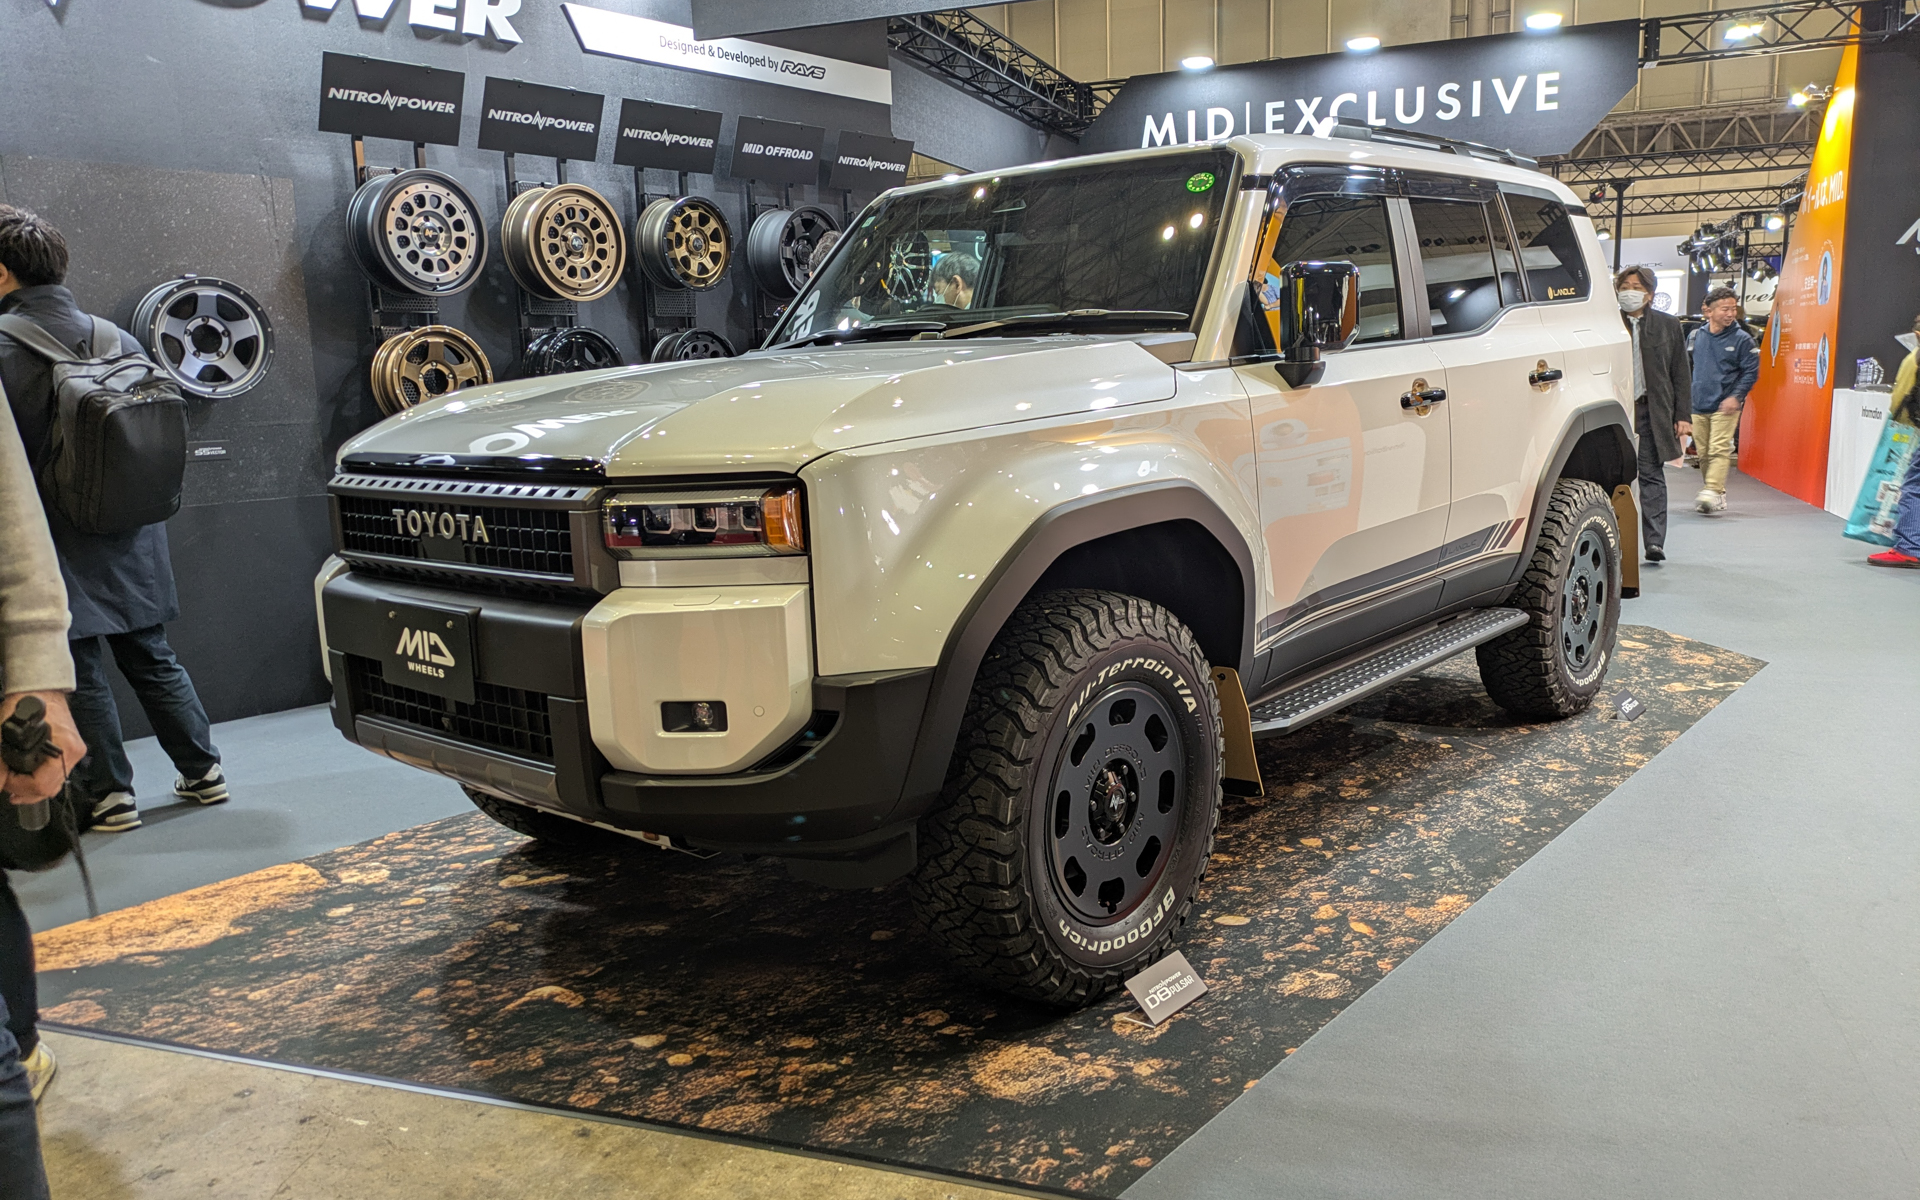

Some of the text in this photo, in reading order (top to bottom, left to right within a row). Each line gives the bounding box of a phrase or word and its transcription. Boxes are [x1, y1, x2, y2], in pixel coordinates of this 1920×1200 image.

[659, 35, 826, 80] Designed & Developed by RAYS
[1141, 72, 1560, 148] MID EXCLUSIVE
[742, 142, 813, 161] MID OFFROAD
[1862, 405, 1883, 420] Information
[392, 508, 490, 543] TOYOTA
[396, 626, 456, 667] MID
[407, 660, 445, 678] WHEELS
[1066, 657, 1174, 728] All-Terrain
[1173, 674, 1198, 713] T/A
[1059, 885, 1176, 955] BFGoodrich
[1168, 974, 1195, 996] PULSAR
